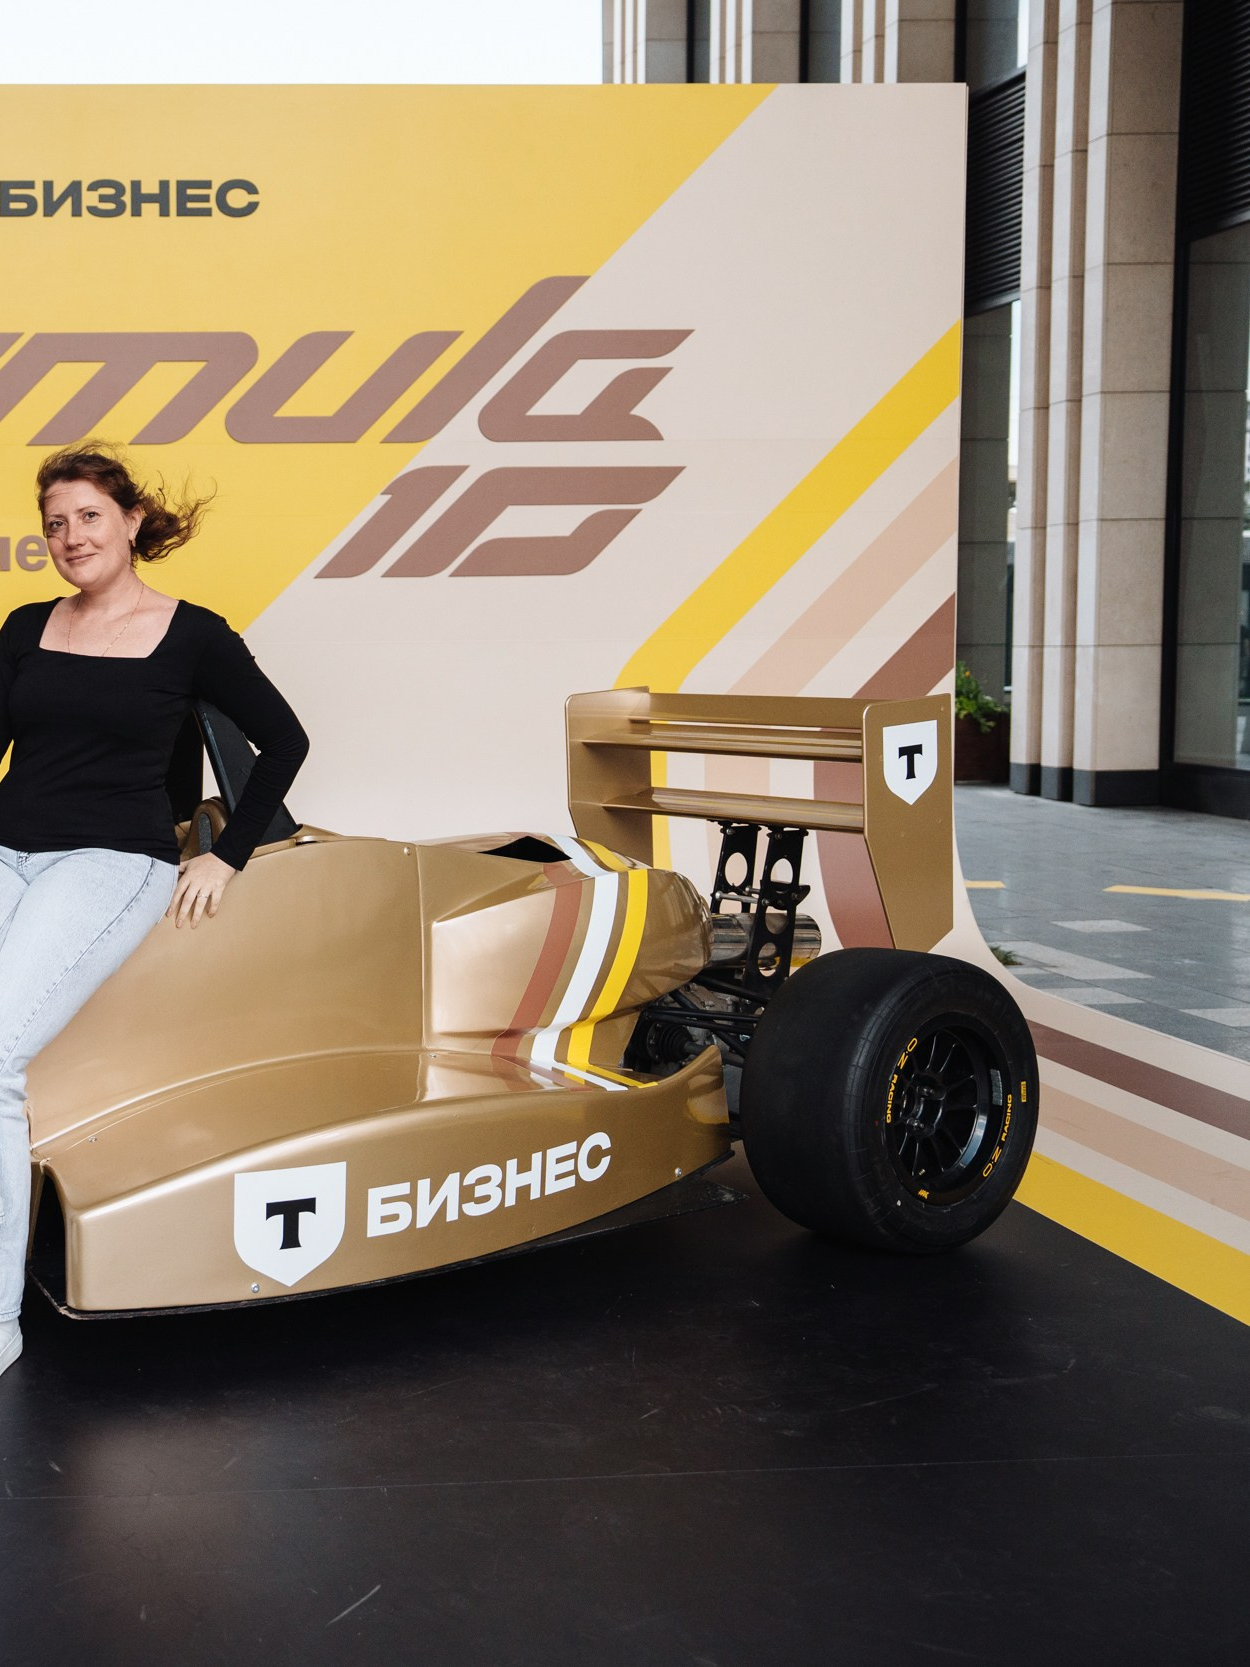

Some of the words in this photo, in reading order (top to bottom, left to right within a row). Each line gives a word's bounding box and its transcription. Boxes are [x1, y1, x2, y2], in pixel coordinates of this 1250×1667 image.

[886, 1073, 899, 1124] RACING
[1001, 1093, 1013, 1142] RACING
[265, 1196, 317, 1251] Т
[366, 1131, 612, 1238] БИЗНЕС
